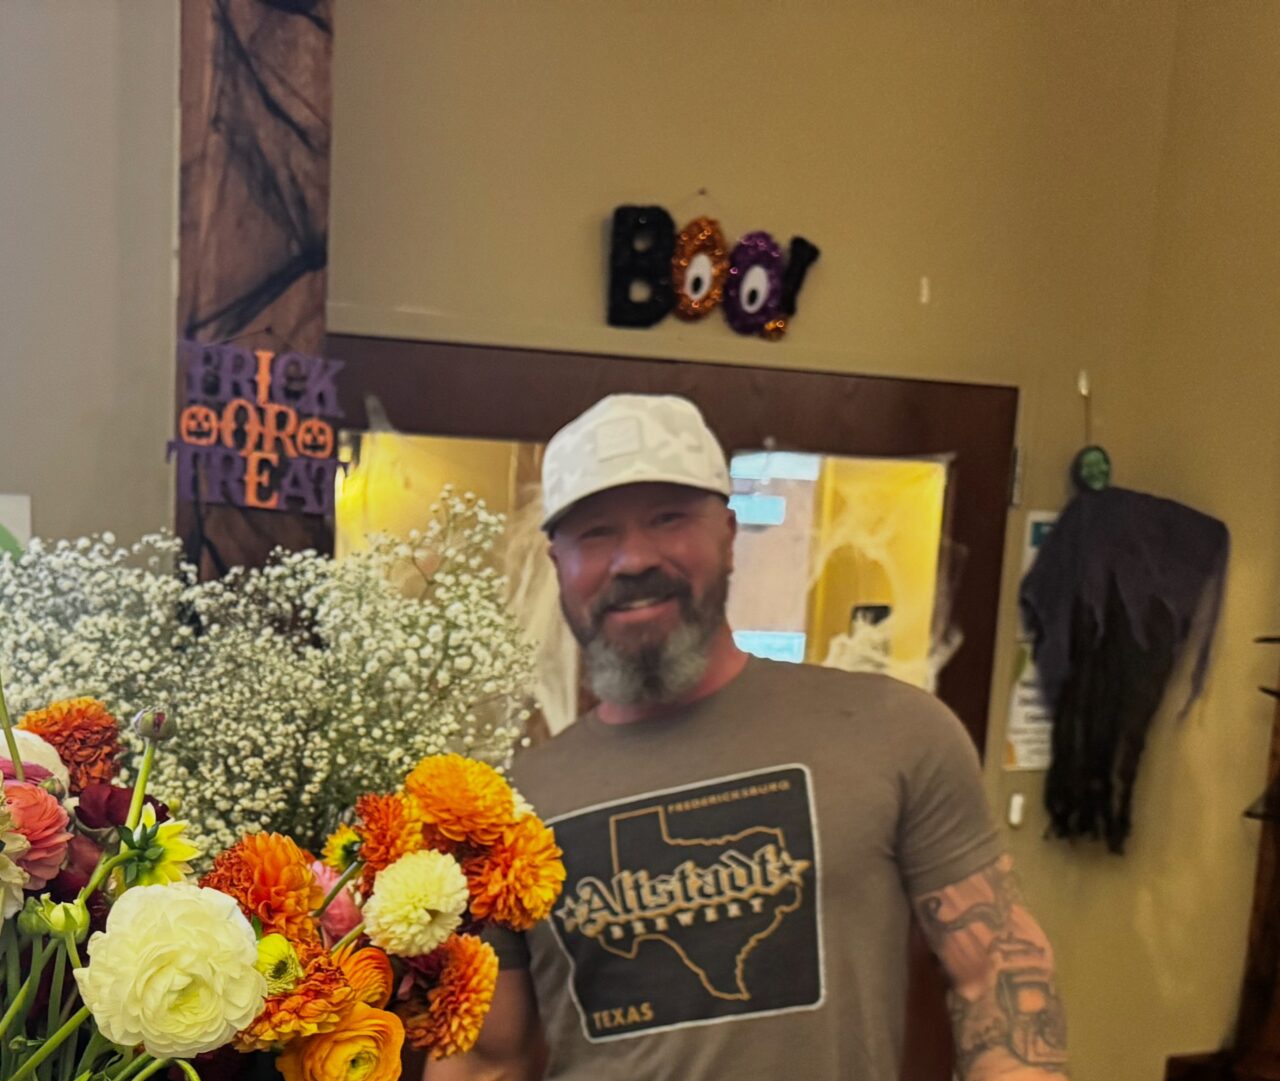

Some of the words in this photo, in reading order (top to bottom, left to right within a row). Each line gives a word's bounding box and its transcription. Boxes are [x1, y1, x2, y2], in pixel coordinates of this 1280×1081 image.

[221, 398, 298, 458] OR
[166, 440, 350, 516] TREAT
[593, 1003, 654, 1030] TEXAS
